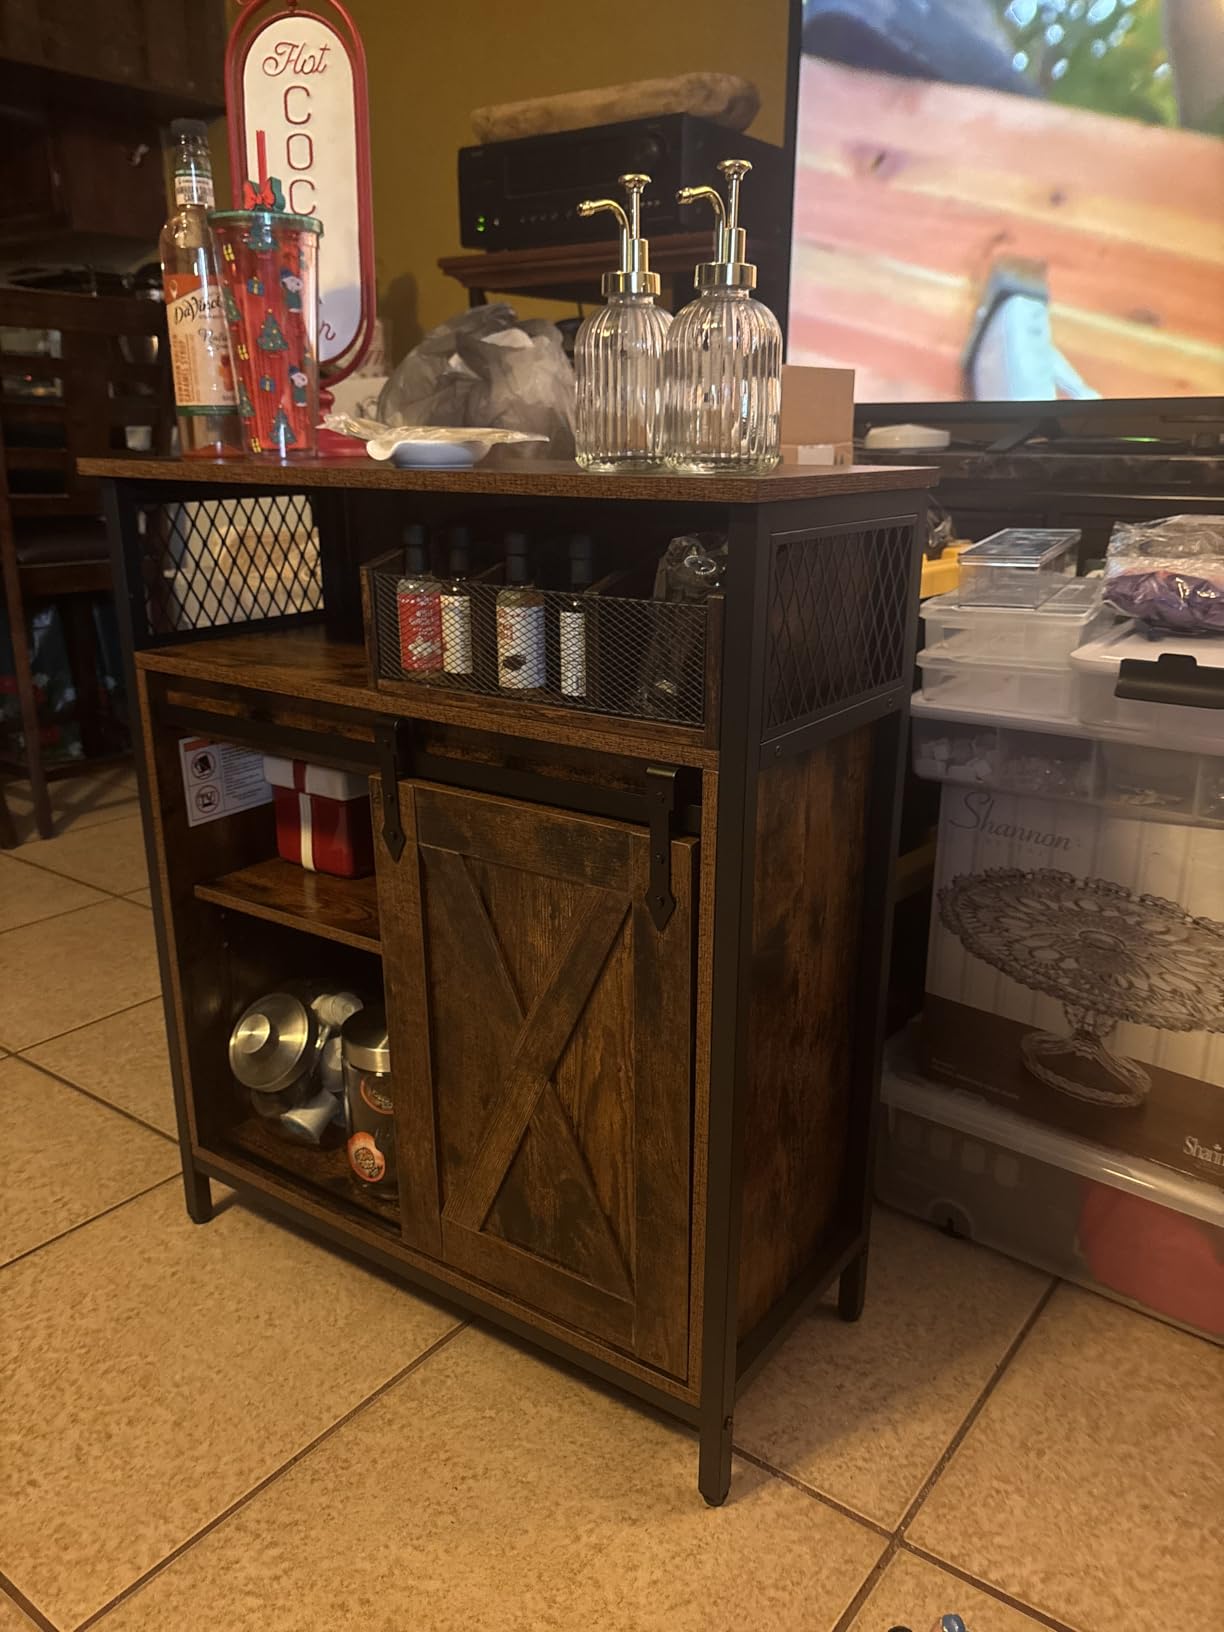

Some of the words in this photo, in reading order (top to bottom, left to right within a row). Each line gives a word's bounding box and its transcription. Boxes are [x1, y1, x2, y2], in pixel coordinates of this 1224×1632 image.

[262, 41, 331, 77] Hot
[283, 85, 317, 216] COC
[948, 791, 1071, 850] Shannon
[1183, 1135, 1224, 1167] Shann
